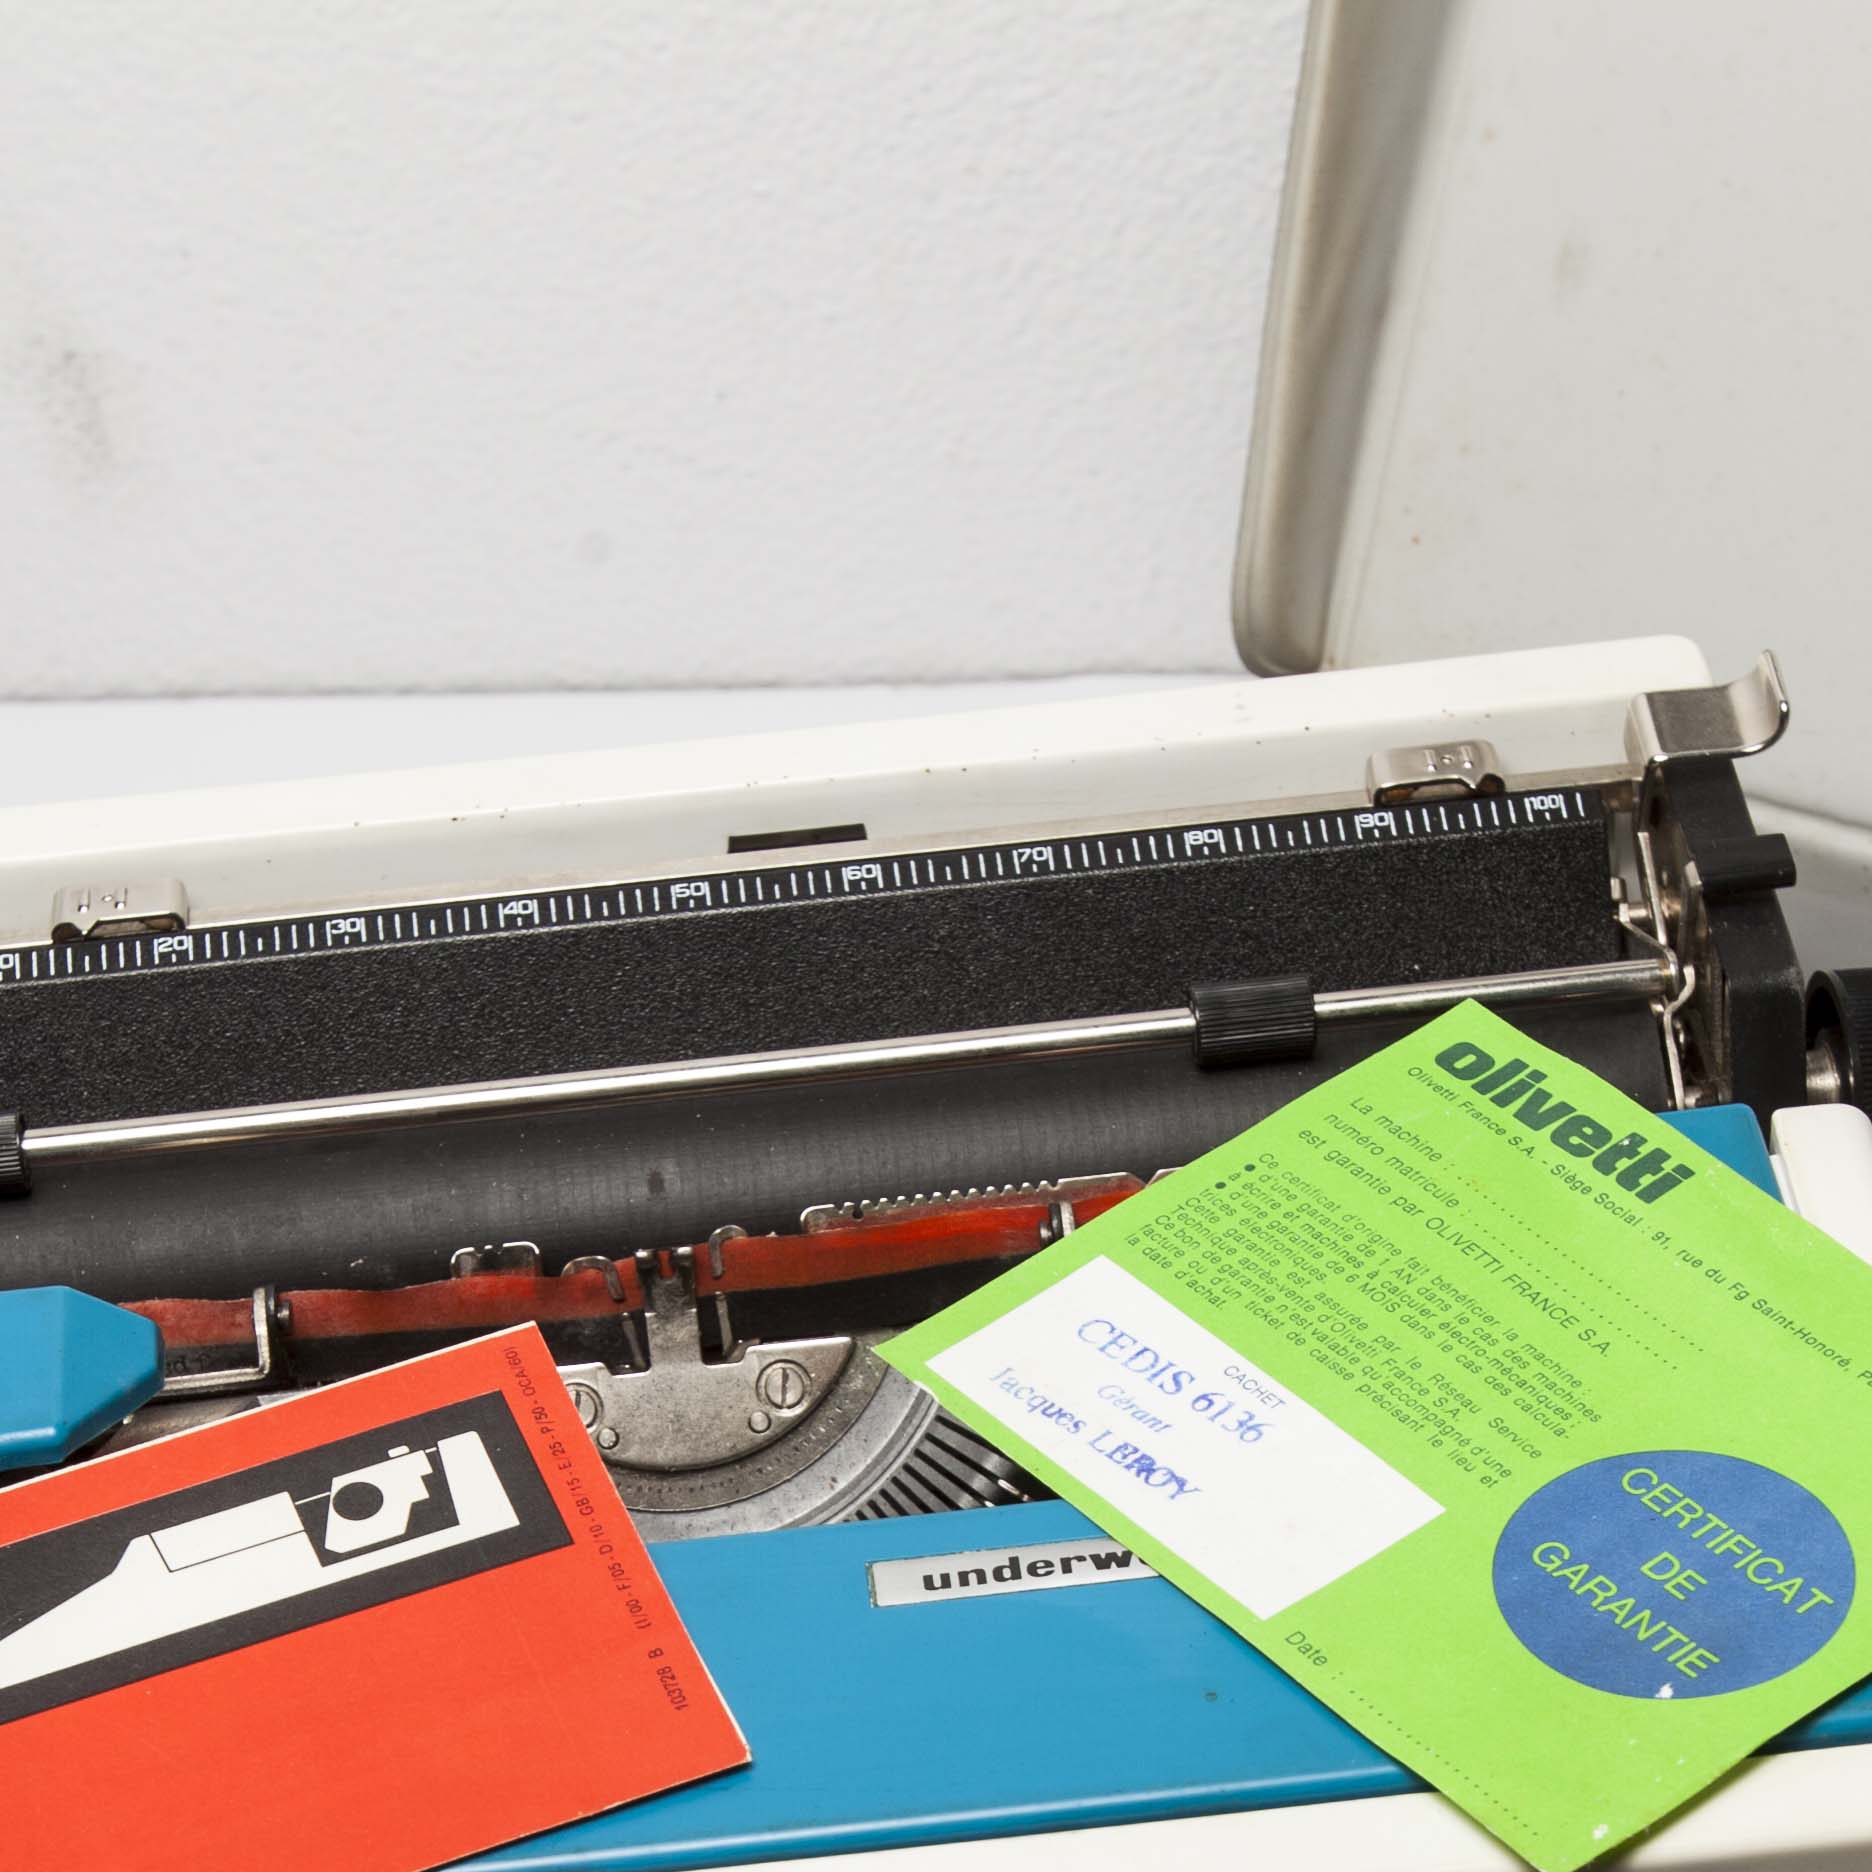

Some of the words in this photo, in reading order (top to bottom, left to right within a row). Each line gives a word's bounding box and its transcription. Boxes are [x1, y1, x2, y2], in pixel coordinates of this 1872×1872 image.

[158, 935, 189, 953] 20
[330, 916, 362, 935] 30
[502, 898, 534, 918] 40
[675, 881, 707, 901] 50
[847, 863, 877, 882] 60
[1018, 845, 1049, 864] 70
[1188, 827, 1220, 847] 80
[1358, 811, 1390, 830] 90
[1530, 794, 1563, 814] 100
[1322, 1112, 1385, 1156] numéro
[1382, 1155, 1460, 1209] matricule
[1348, 1095, 1374, 1116] La
[1372, 1114, 1443, 1162] machine
[1406, 1065, 1461, 1102] Olivetti
[1456, 1099, 1507, 1136] France
[1506, 1134, 1536, 1160] S.A.
[1548, 1162, 1593, 1196] Siège
[1592, 1191, 1644, 1227] Social
[1649, 1230, 1672, 1250] 91,
[1674, 1248, 1704, 1269] rue
[1703, 1267, 1727, 1285] du
[1726, 1280, 1751, 1302] Fg
[1432, 1040, 1697, 1205] olivetti
[1122, 1231, 1141, 1247] la
[1140, 1246, 1173, 1270] date
[1169, 1202, 1238, 1256] Technique
[1236, 1256, 1316, 1313] après-vente
[1316, 1312, 1382, 1359] d'Olivetti
[1379, 1356, 1430, 1397] France
[1257, 1151, 1280, 1170] Ce
[1279, 1170, 1342, 1213] certificat
[1340, 1213, 1403, 1257] d'origine
[1402, 1255, 1431, 1277] fait
[1501, 1326, 1520, 1342] la
[1519, 1342, 1583, 1389] machine
[1257, 1173, 1298, 1202] d'une
[1294, 1201, 1355, 1242] garantie
[1354, 1242, 1377, 1258] de
[1388, 1266, 1418, 1286] AN
[1415, 1285, 1453, 1313] dans
[1452, 1310, 1471, 1325] le
[1471, 1326, 1500, 1347] cas
[1500, 1347, 1531, 1370] des
[1531, 1371, 1602, 1423] machines
[1297, 1128, 1327, 1150] est
[1322, 1148, 1392, 1196] garantie
[1387, 1195, 1425, 1217] par
[1424, 1215, 1505, 1274] OLIVETTI
[1500, 1272, 1581, 1330] FRANCE
[1576, 1327, 1611, 1358] S.A.
[1074, 1314, 1200, 1397] CEDIS
[1188, 1391, 1277, 1444] 6136
[1153, 1213, 1176, 1231] Ce
[1172, 1226, 1201, 1250] bon
[1200, 1249, 1222, 1265] de
[1215, 1262, 1276, 1304] garantie
[1274, 1303, 1314, 1331] n'est
[1310, 1326, 1361, 1365] valable
[1469, 1445, 1513, 1479] d'une
[1183, 1195, 1221, 1224] Cette
[1221, 1227, 1281, 1268] garantie
[1285, 1270, 1312, 1289] est
[1312, 1290, 1369, 1331] assurée
[1369, 1334, 1402, 1353] par
[1404, 1354, 1423, 1371] le
[1426, 1371, 1483, 1415] Réseau
[1486, 1415, 1543, 1460] Service
[1222, 1364, 1287, 1409] CACHET
[985, 1365, 1092, 1436] Jacques
[1084, 1427, 1204, 1502] LEROY
[1093, 1383, 1174, 1436] Gérant
[1530, 1539, 1722, 1679] GARANTIE
[1619, 1466, 1835, 1615] CERTIFICAT
[1638, 1550, 1709, 1602] DE
[654, 1664, 691, 1712] 103728
[1282, 1629, 1328, 1667] Date
